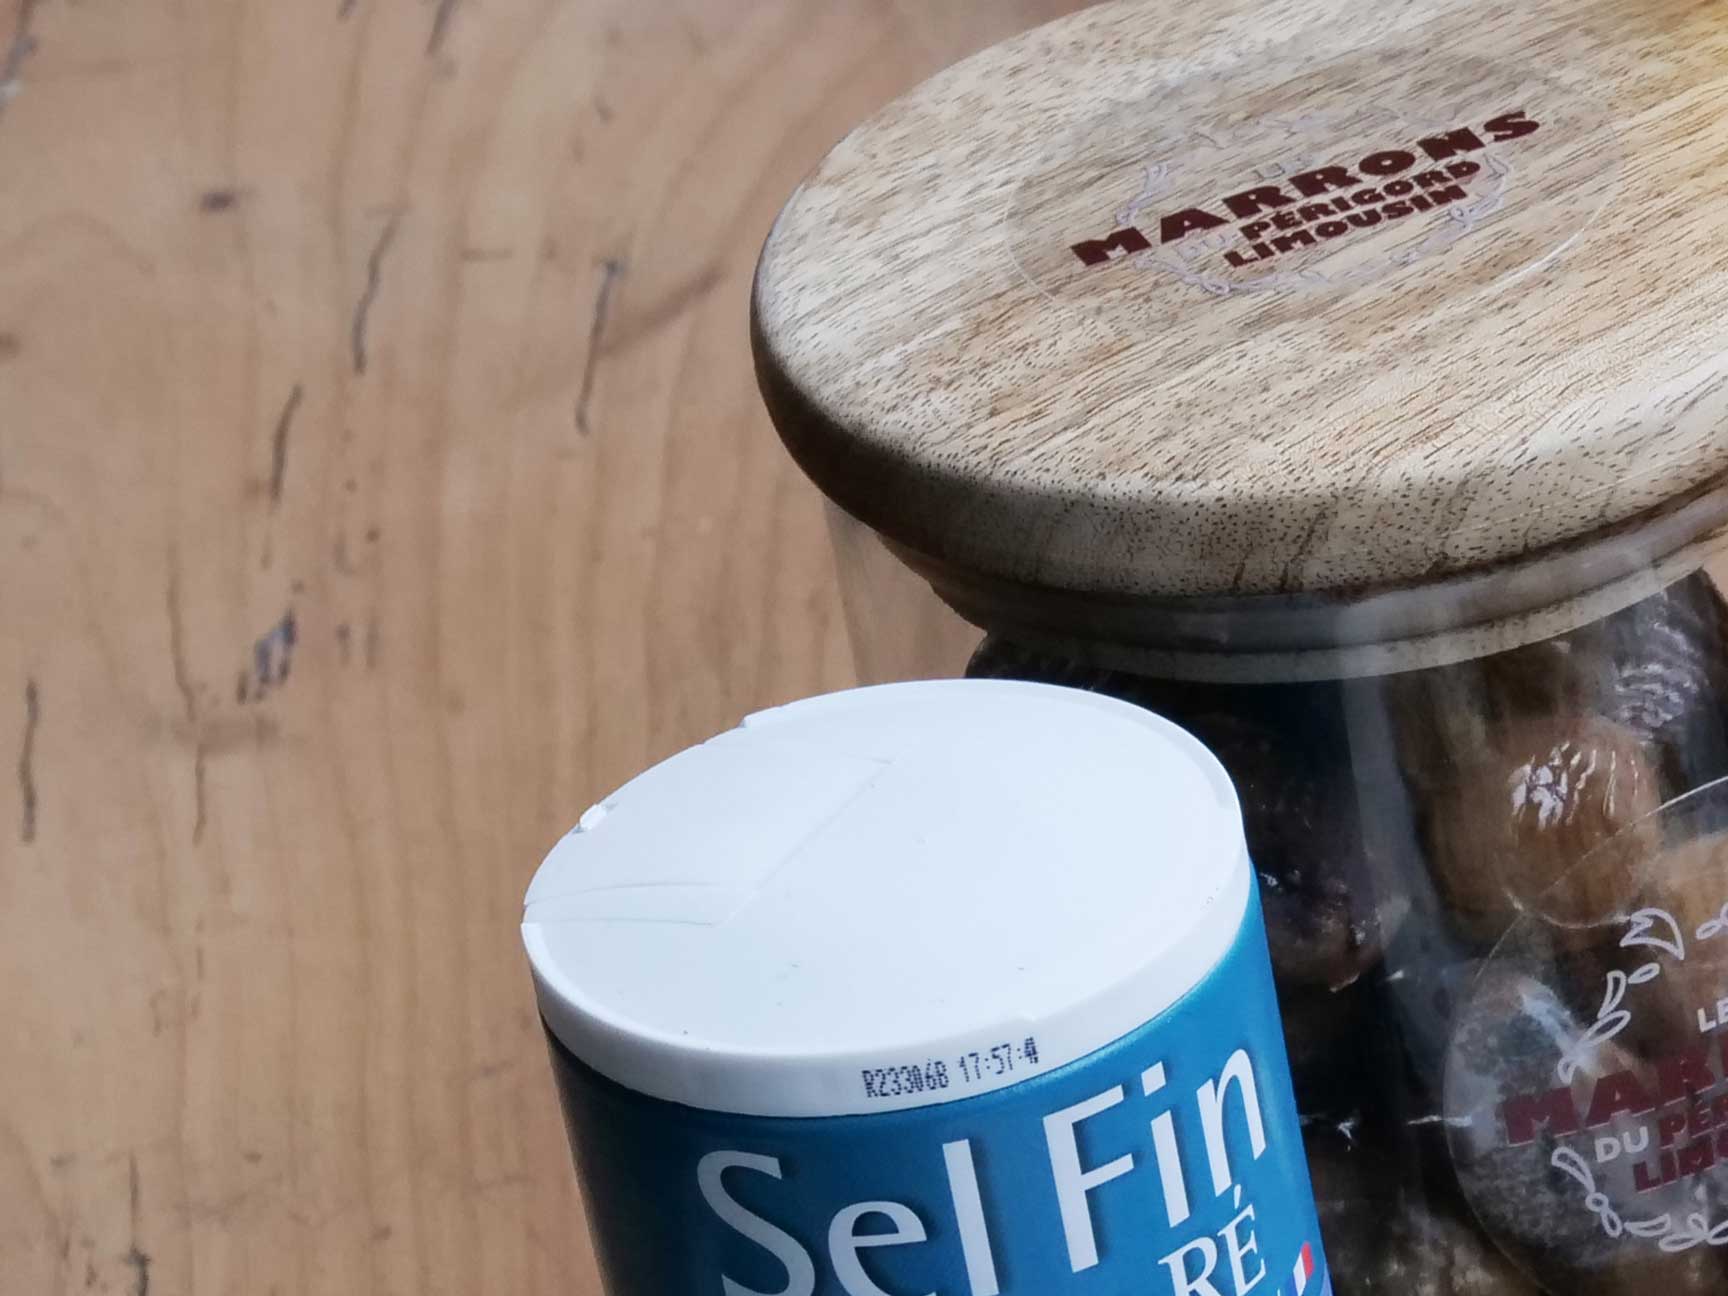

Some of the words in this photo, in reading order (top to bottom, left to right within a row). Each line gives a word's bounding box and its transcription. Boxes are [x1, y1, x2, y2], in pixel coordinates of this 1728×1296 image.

[1071, 110, 1541, 267] MARRONS
[1223, 183, 1468, 268] LIMOUSIN
[1238, 160, 1482, 243] PÉRIGORD
[1042, 1047, 1268, 1274] Fin
[1594, 1127, 1649, 1163] DU
